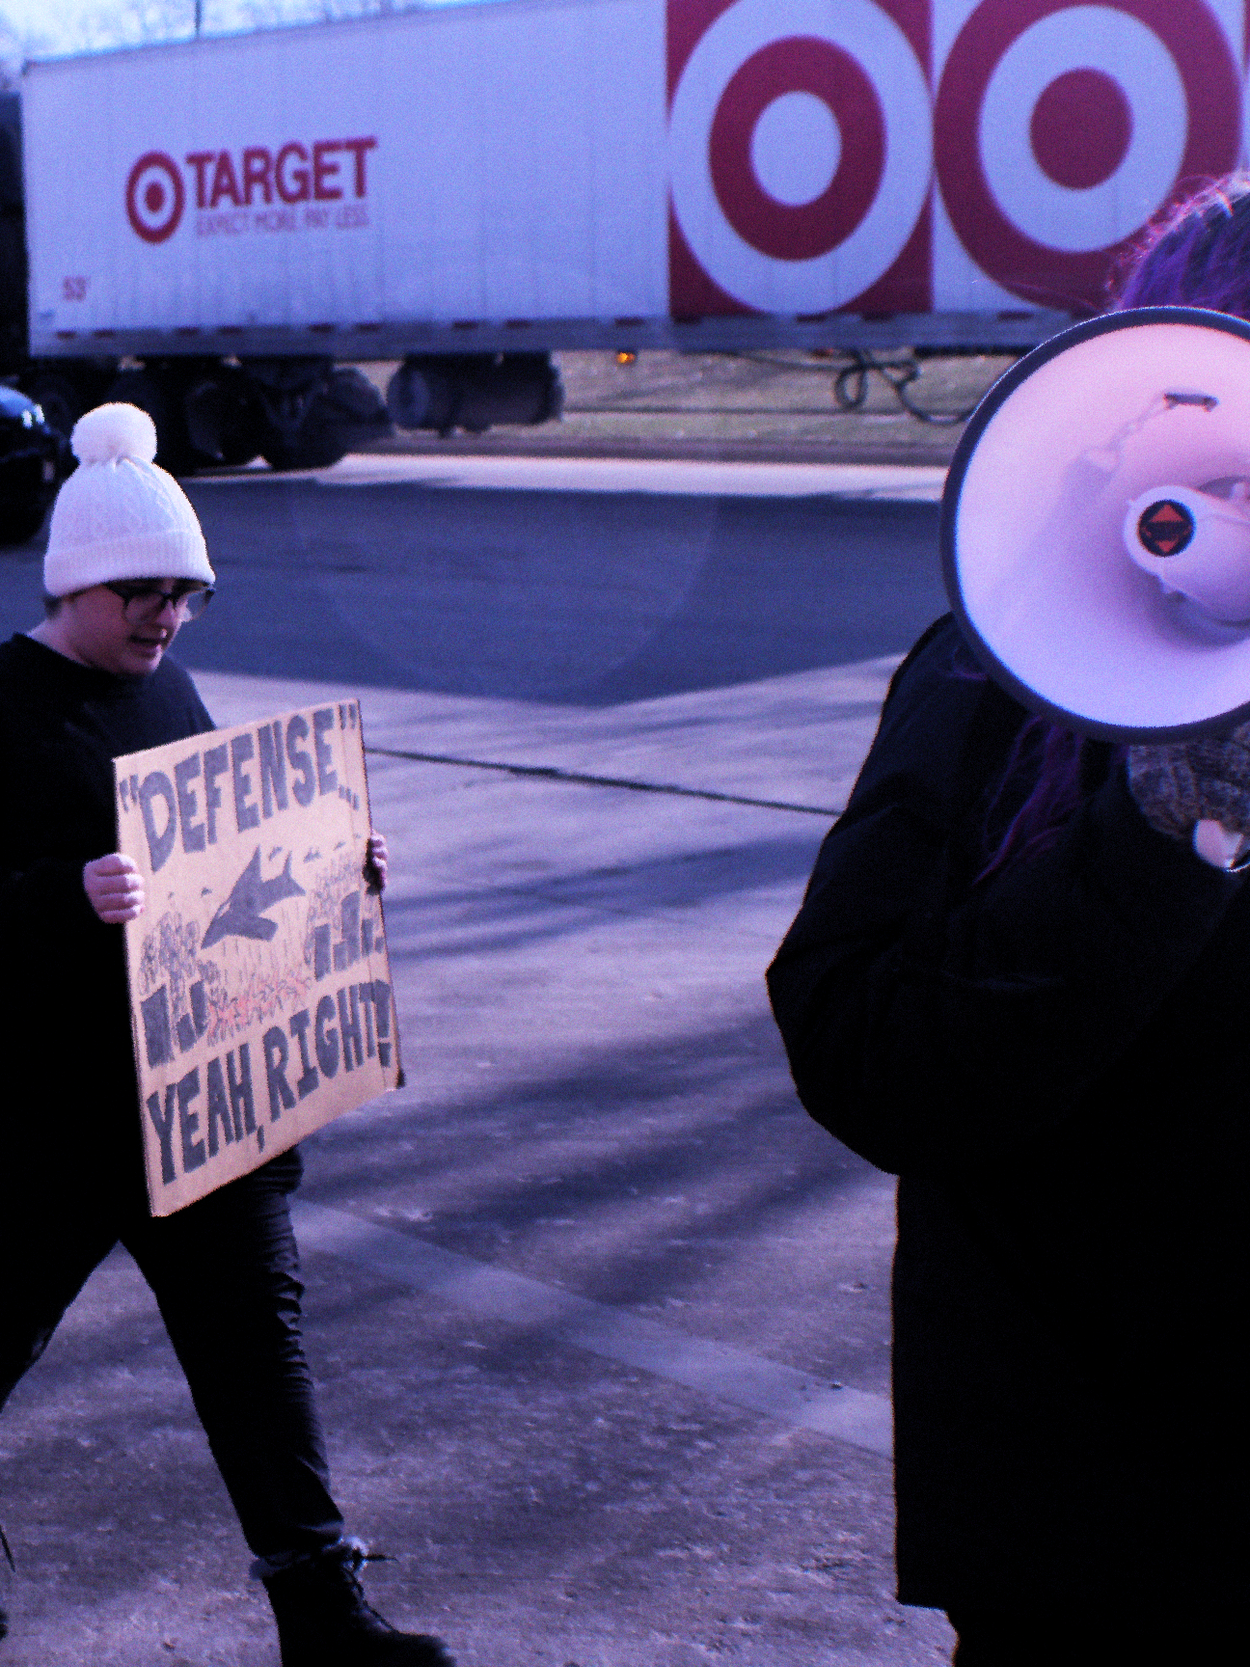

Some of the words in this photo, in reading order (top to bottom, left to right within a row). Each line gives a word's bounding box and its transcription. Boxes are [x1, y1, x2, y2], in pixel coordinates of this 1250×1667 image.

[185, 135, 378, 208] TARGET
[146, 1042, 265, 1186] YEAH,
[262, 978, 392, 1123] RIGHT!
